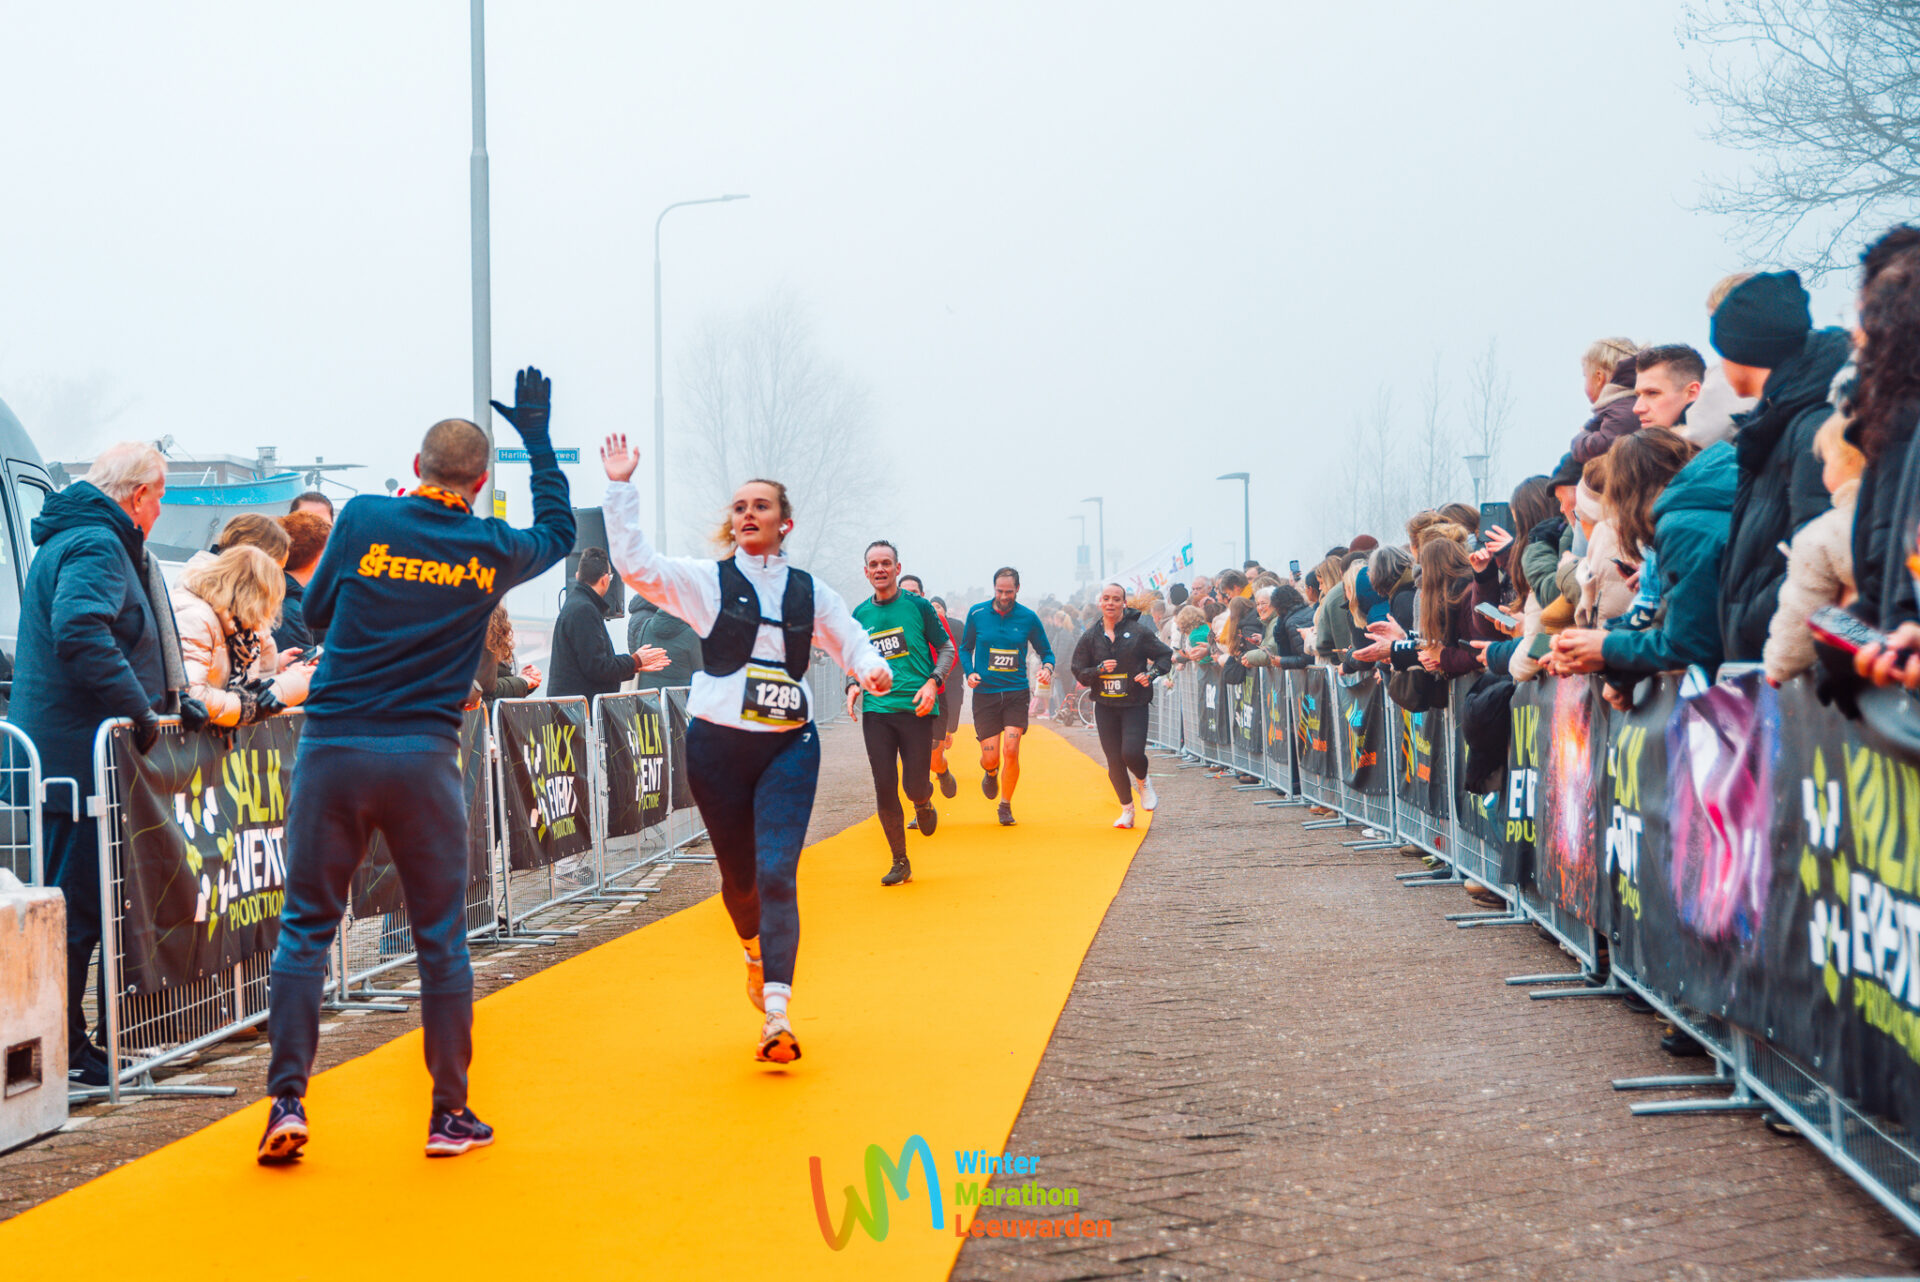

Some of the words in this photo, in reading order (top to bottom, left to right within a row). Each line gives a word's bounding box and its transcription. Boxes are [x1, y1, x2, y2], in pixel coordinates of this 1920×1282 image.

[369, 543, 390, 556] DE
[873, 636, 900, 653] 2188
[994, 656, 1014, 666] 2271
[756, 682, 801, 710] 1289
